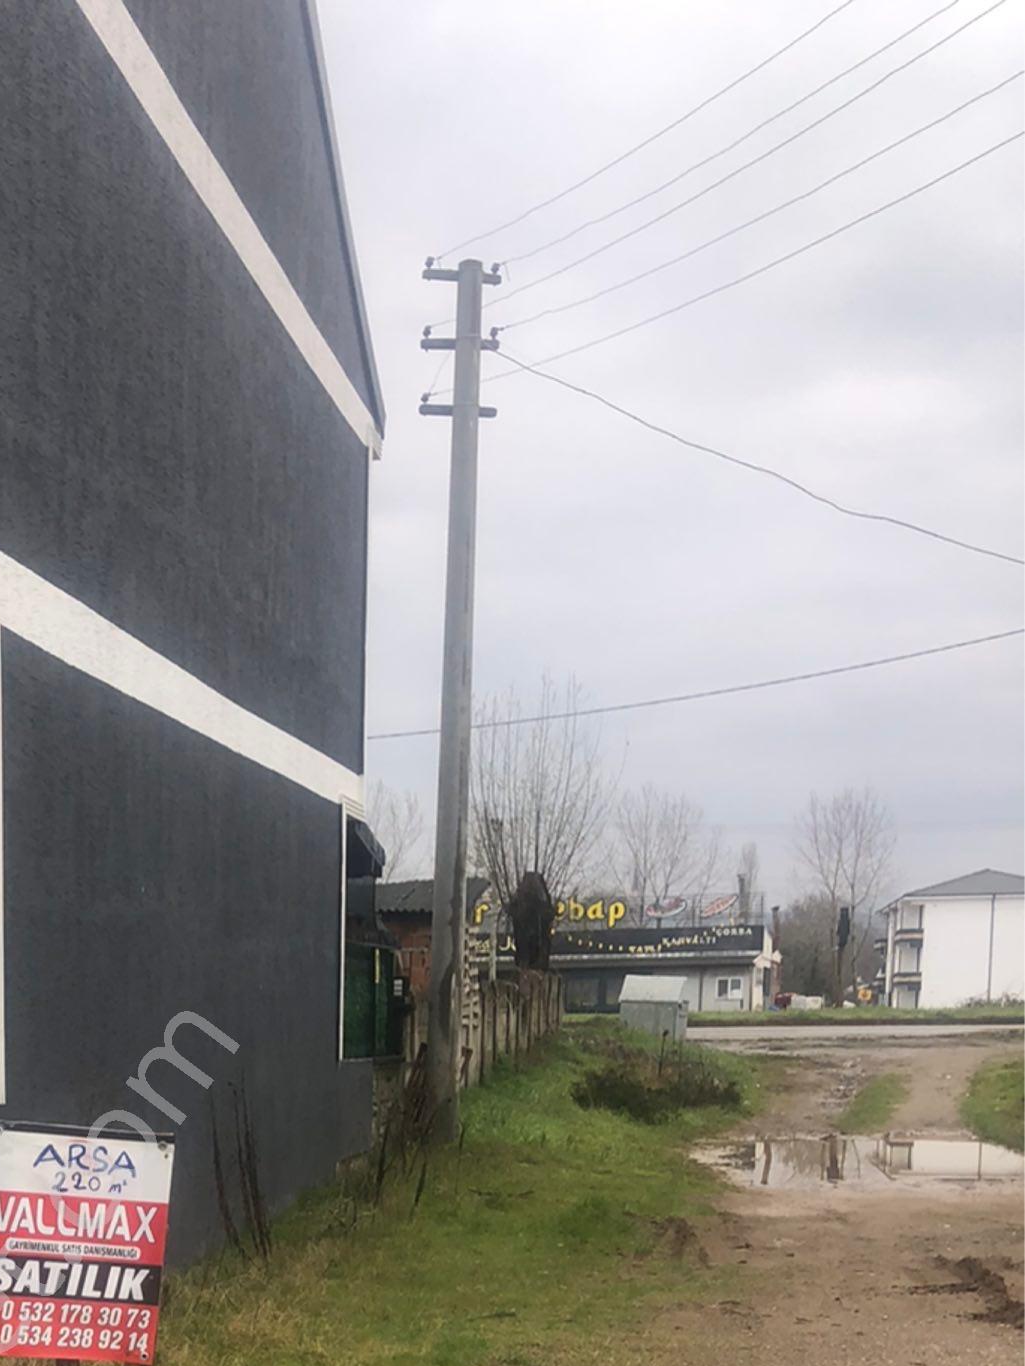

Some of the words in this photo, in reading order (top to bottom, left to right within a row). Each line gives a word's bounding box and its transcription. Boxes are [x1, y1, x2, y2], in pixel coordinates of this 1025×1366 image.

[33, 1144, 137, 1178] ARSA
[51, 1171, 100, 1192] 220
[1, 1301, 14, 1320] 0
[18, 1302, 54, 1322] 532
[60, 1304, 92, 1325] 178
[98, 1307, 122, 1327] 30
[127, 1309, 151, 1329] 73
[0, 1325, 12, 1344] 0
[17, 1326, 52, 1346] 534
[57, 1327, 93, 1348] 238
[98, 1330, 124, 1350] 92
[128, 1333, 149, 1352] 14
